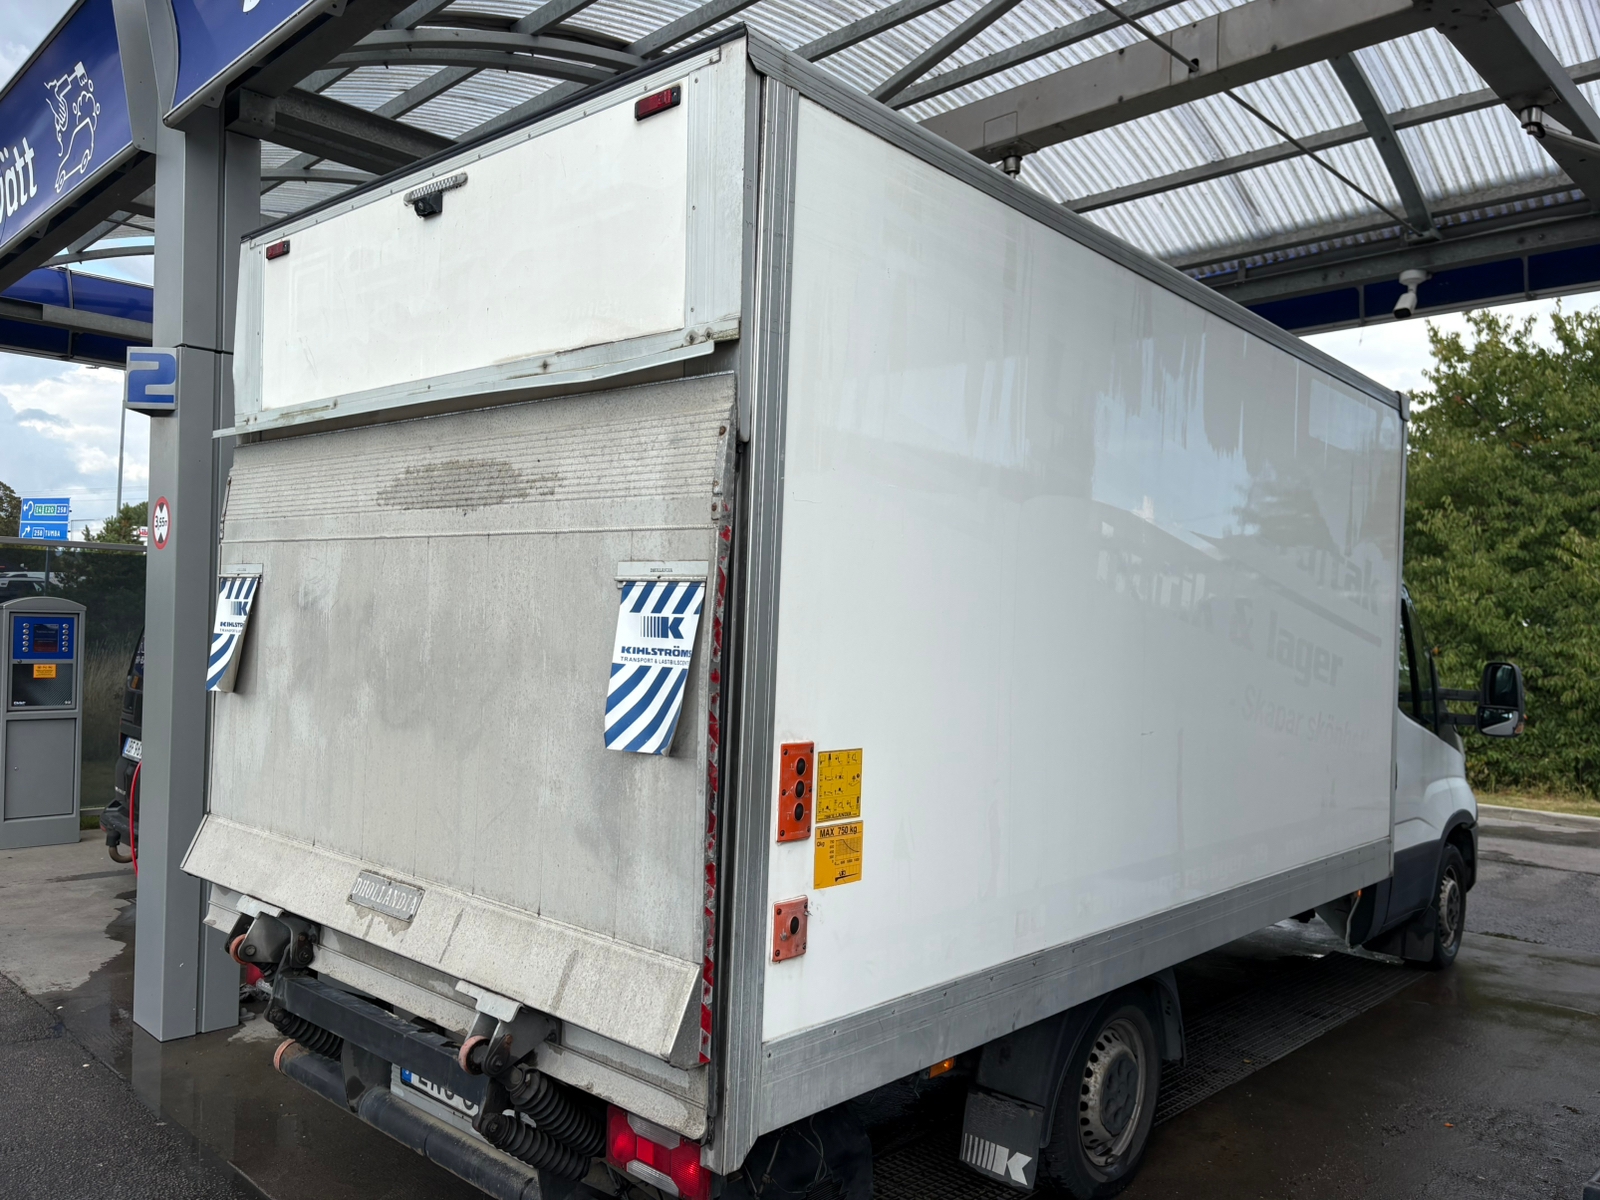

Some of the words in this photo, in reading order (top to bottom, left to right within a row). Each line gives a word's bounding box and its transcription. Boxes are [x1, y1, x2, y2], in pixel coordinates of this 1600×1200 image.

[128, 352, 176, 404] 2
[1266, 610, 1344, 688] lager
[819, 828, 835, 839] MAX
[837, 825, 849, 836] 750
[849, 824, 858, 835] kg
[352, 878, 417, 914] DHOLLANDIA
